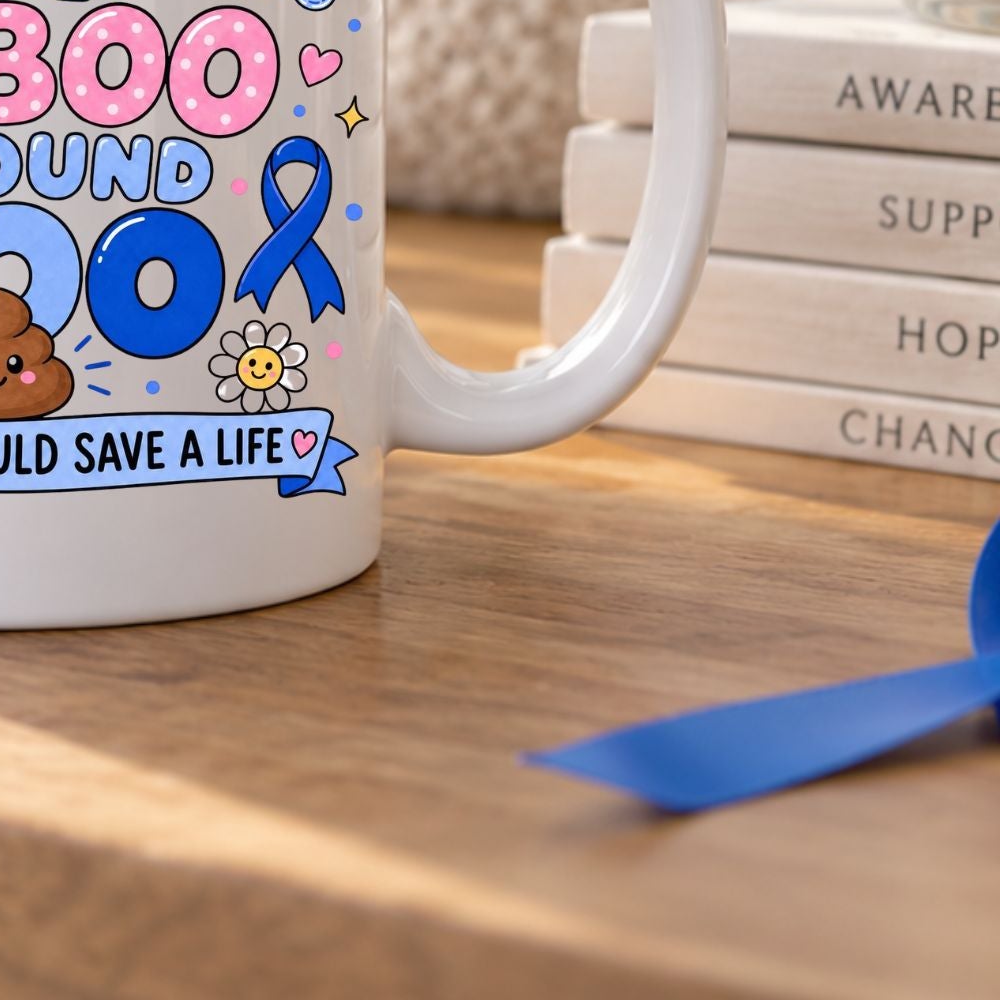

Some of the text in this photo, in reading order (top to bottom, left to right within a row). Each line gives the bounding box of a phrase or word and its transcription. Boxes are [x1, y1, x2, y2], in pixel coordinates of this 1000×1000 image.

[878, 194, 1000, 238] SUPP
[898, 315, 1000, 361] HOP
[74, 430, 167, 475] SAVE
[181, 430, 204, 468] A
[216, 426, 285, 467] LIFE
